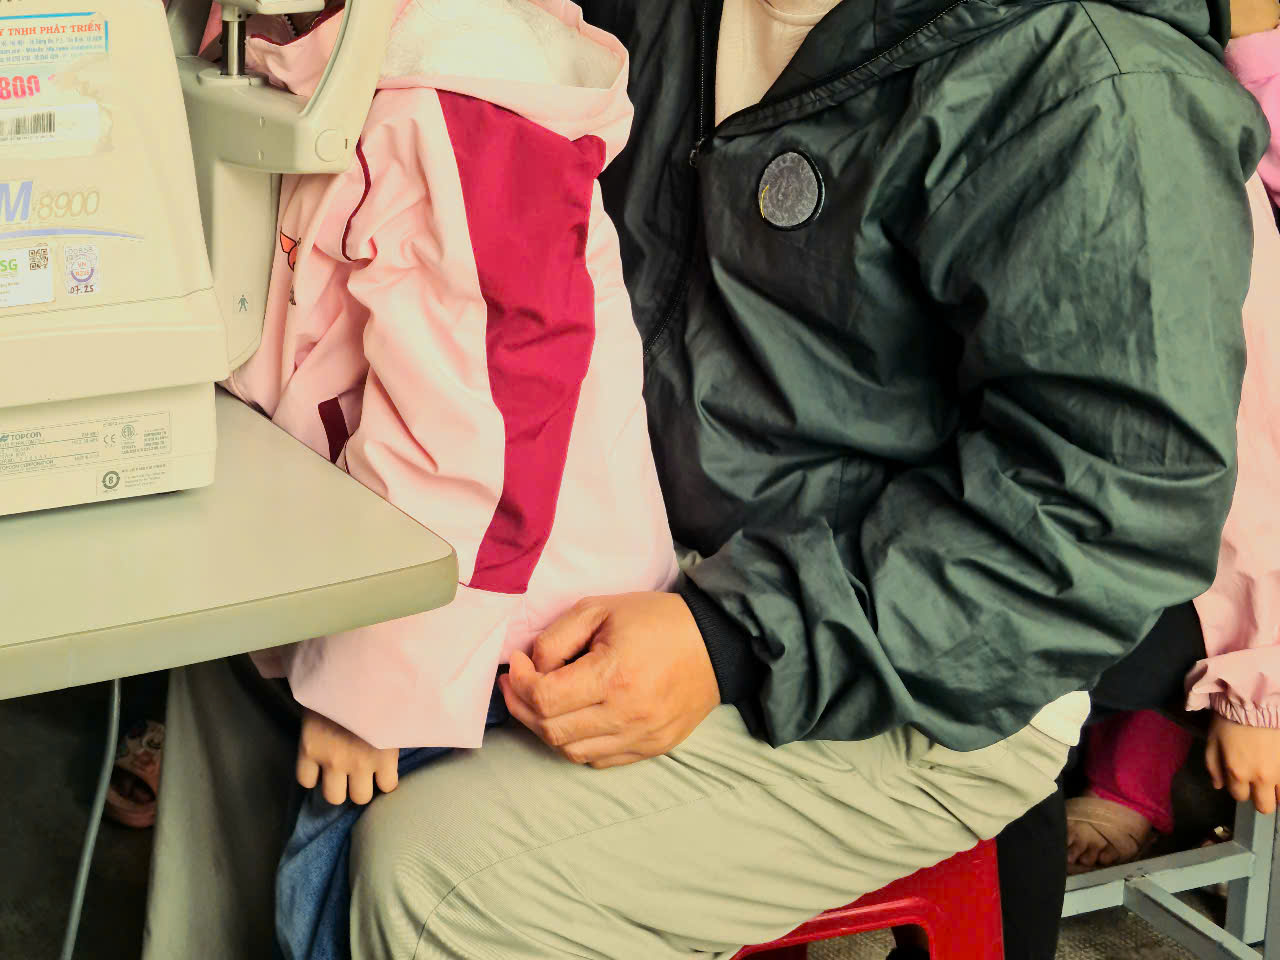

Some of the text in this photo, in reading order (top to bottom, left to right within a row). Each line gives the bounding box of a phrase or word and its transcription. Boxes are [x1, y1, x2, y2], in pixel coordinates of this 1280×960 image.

[8, 26, 37, 37] TNHH
[37, 189, 100, 220] 8900
[11, 431, 42, 441] TOPCON
